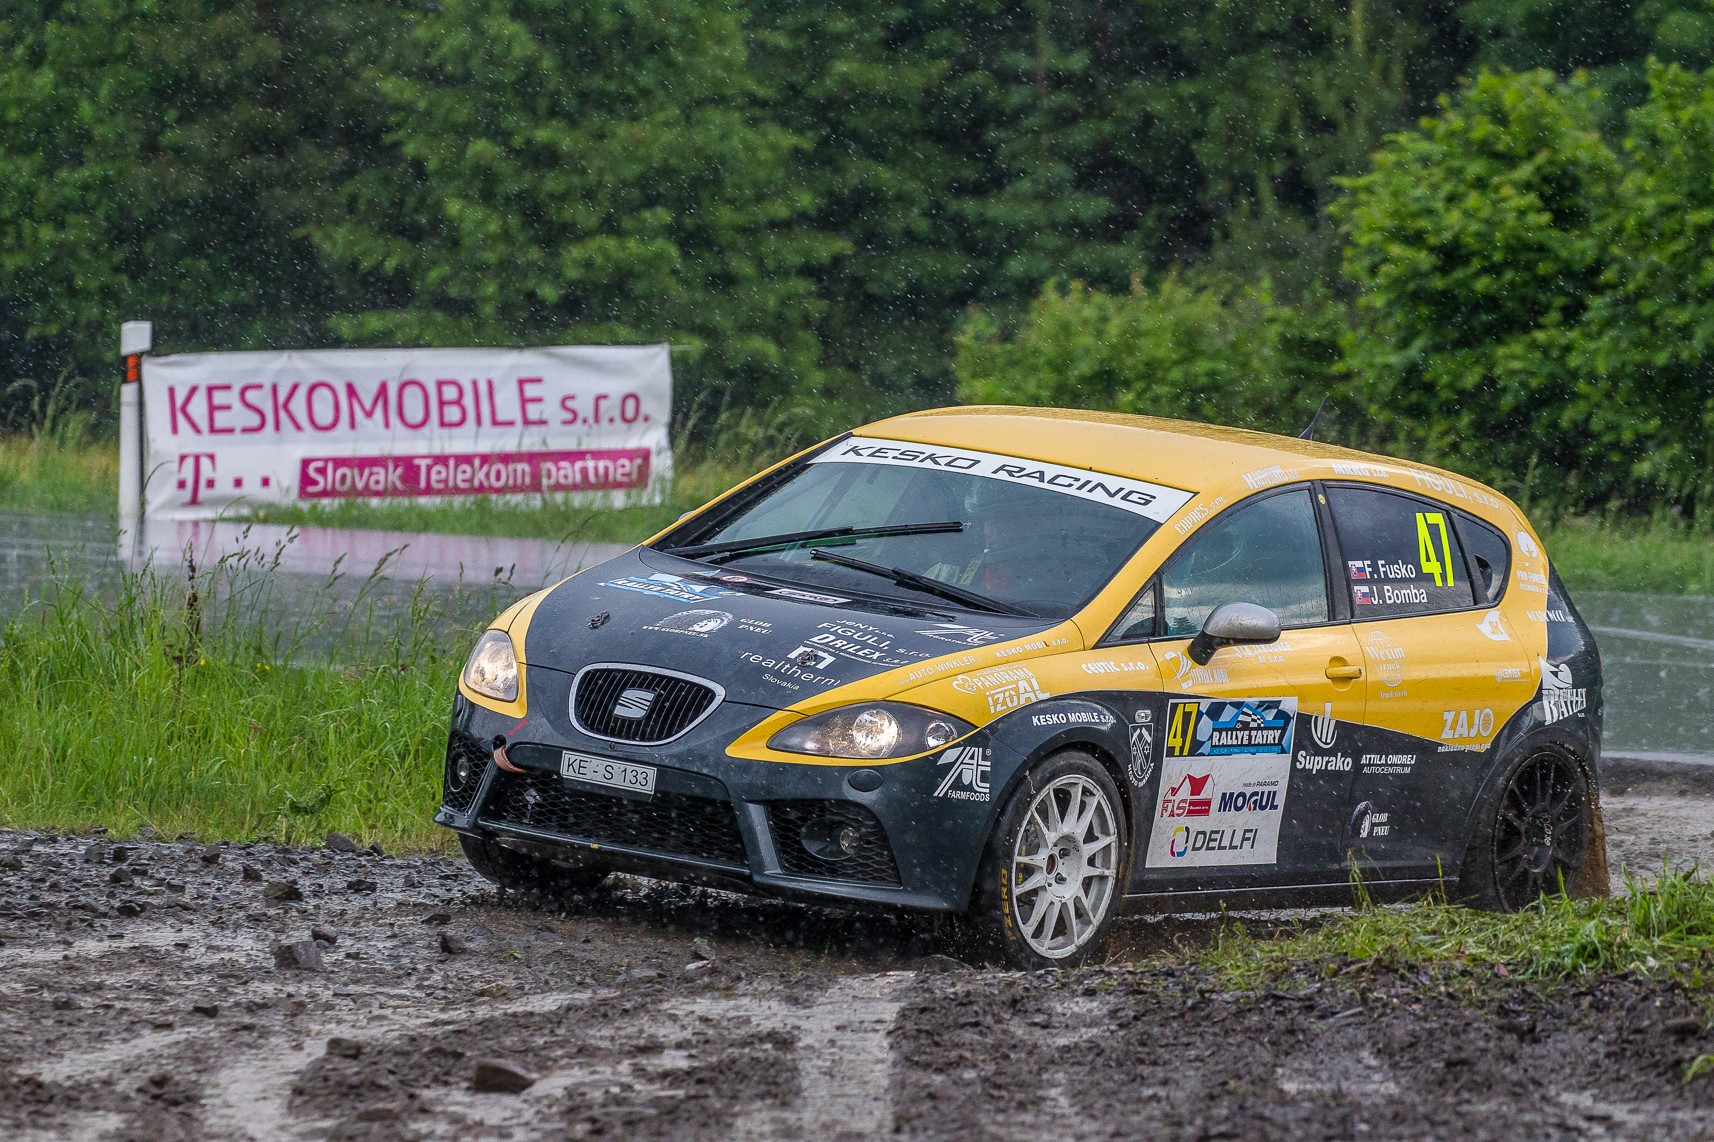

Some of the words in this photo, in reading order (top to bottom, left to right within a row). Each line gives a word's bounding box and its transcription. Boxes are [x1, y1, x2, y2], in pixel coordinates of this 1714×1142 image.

[167, 377, 548, 436] KESKOMOBILE
[560, 392, 651, 425] s.r.o.
[304, 459, 403, 493] Slovak
[412, 456, 531, 490] Telekom
[541, 452, 644, 494] partner
[840, 445, 982, 470] KESKO
[991, 463, 1158, 507] RACING
[1415, 512, 1455, 587] 47
[1364, 560, 1378, 579] F.
[1378, 559, 1416, 579] Fusko
[1371, 587, 1383, 605] J.
[1384, 585, 1428, 604] Bomba
[808, 633, 887, 660] DRILEX
[817, 622, 892, 650] FIGULI,
[995, 645, 1023, 658] KESKO
[1365, 644, 1405, 660] Wexim
[762, 673, 800, 691] Slovakia
[972, 667, 1037, 690] PANORAMA
[1032, 713, 1067, 726] KESKO
[1068, 712, 1100, 723] MOBILE
[1168, 703, 1199, 756] 47
[1440, 708, 1494, 739] ZAJO
[1212, 731, 1249, 746] RALLYE
[1250, 730, 1281, 744] TATRY
[1296, 751, 1353, 774] Suprako
[1361, 754, 1386, 764] ATTILA
[1387, 754, 1416, 765] ONDREJ
[1362, 766, 1411, 774] AUTOCENTRUM
[620, 767, 649, 787] 133
[947, 789, 991, 802] FARMFOODS
[1217, 790, 1280, 813] MOGUL
[1191, 828, 1259, 852] DELLFI
[1373, 826, 1390, 836] PNEU
